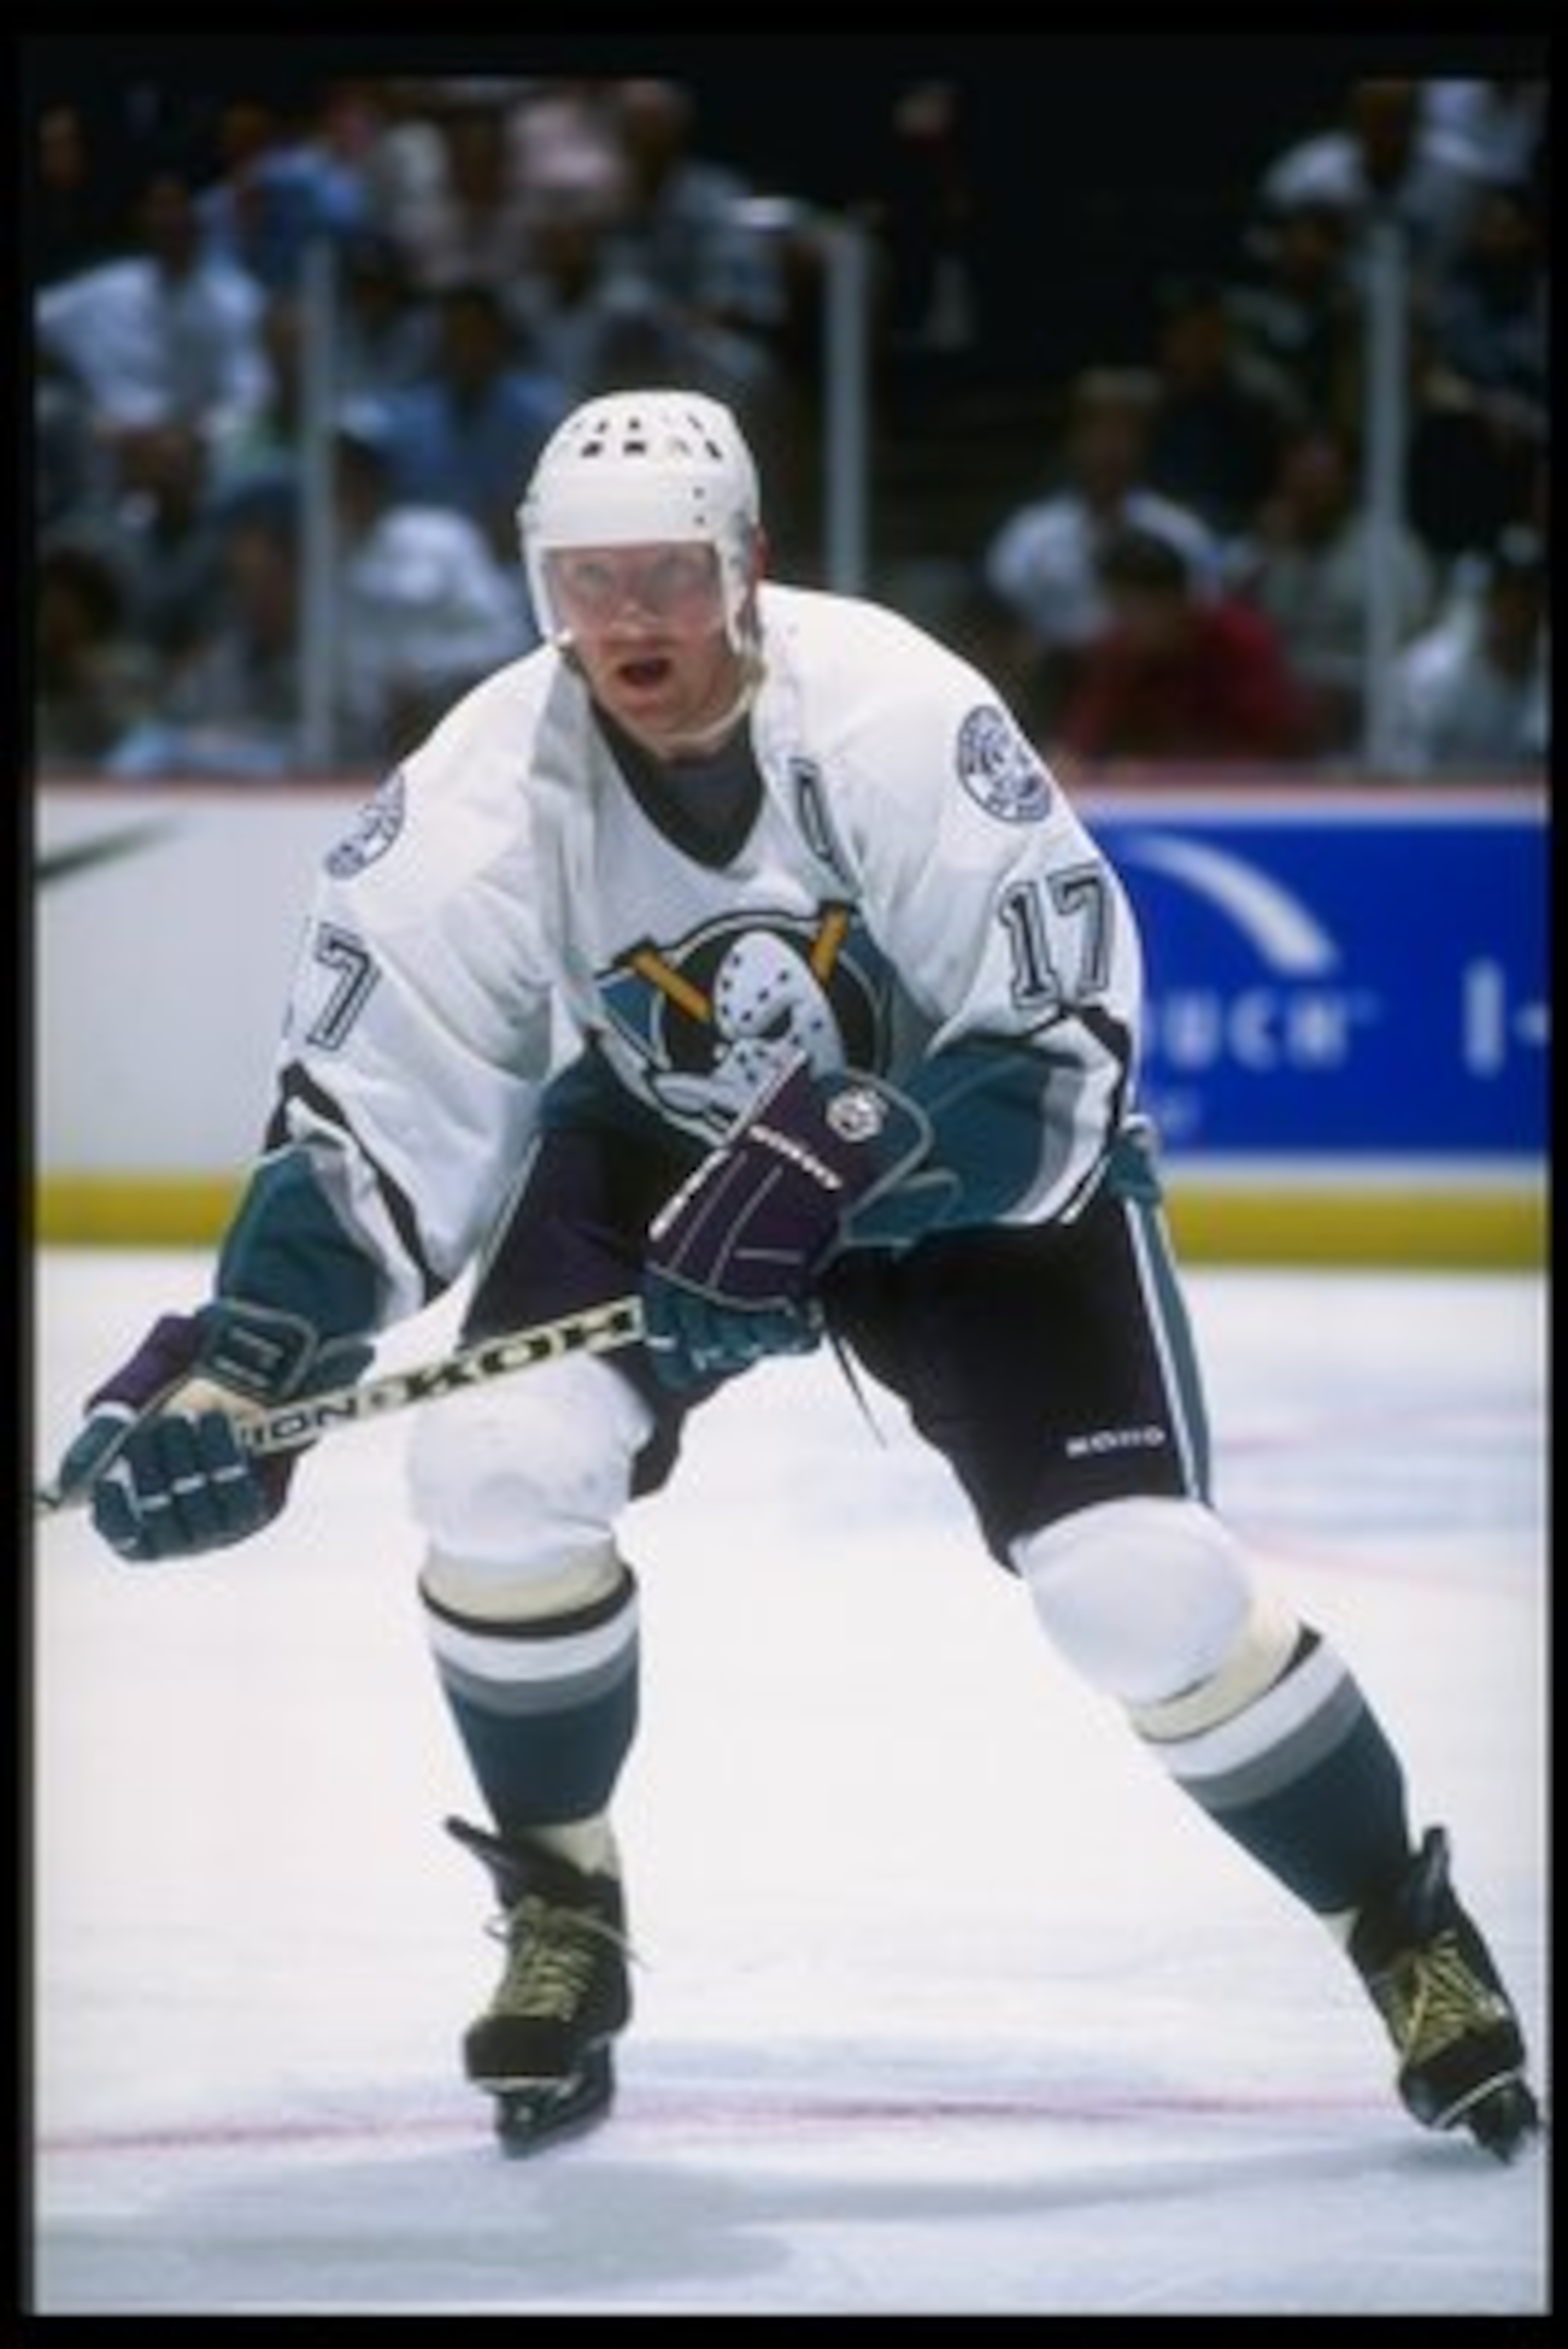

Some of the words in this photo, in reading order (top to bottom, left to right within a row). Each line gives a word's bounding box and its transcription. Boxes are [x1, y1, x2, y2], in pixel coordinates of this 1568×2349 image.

[286, 919, 382, 1051] 7
[999, 862, 1115, 1010] 17
[1143, 988, 1351, 1072] UCH
[245, 1394, 359, 1452] ION
